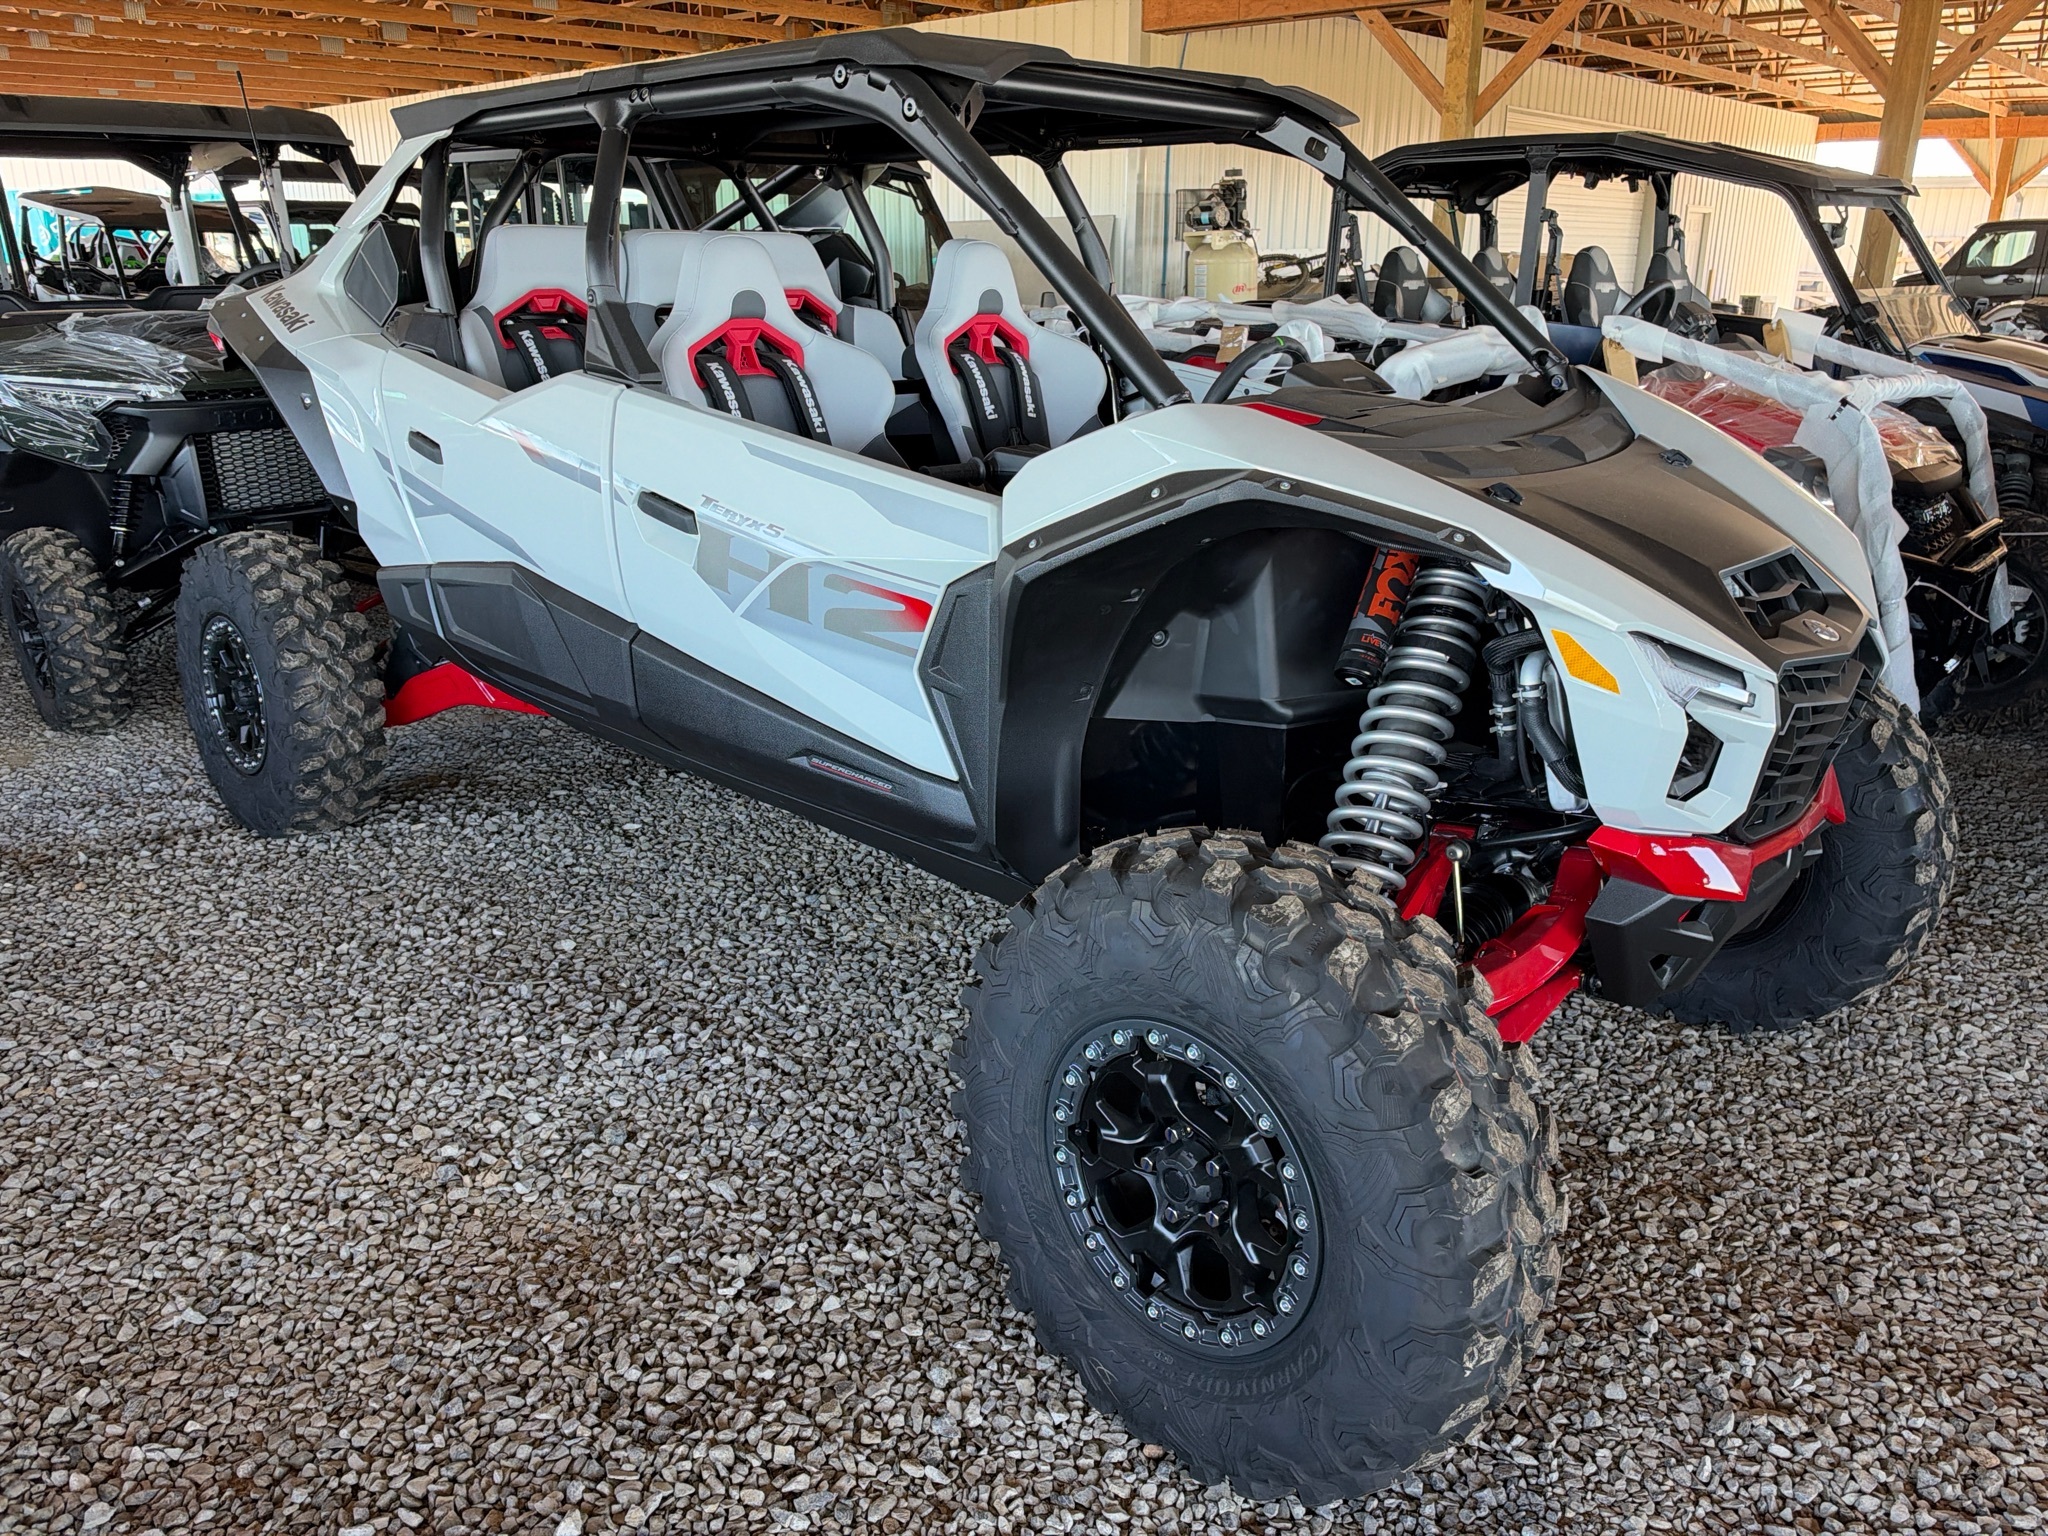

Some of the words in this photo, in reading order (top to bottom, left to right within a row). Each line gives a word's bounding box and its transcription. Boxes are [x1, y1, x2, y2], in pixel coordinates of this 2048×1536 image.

[260, 285, 315, 334] Kawasaki
[782, 358, 827, 434] Kawasaki
[961, 353, 998, 420] Kawasaki
[1010, 351, 1037, 418] Kawasaki
[697, 520, 933, 659] H2
[1366, 549, 1420, 626] FOX
[810, 757, 893, 790] SUPERCHARGED
